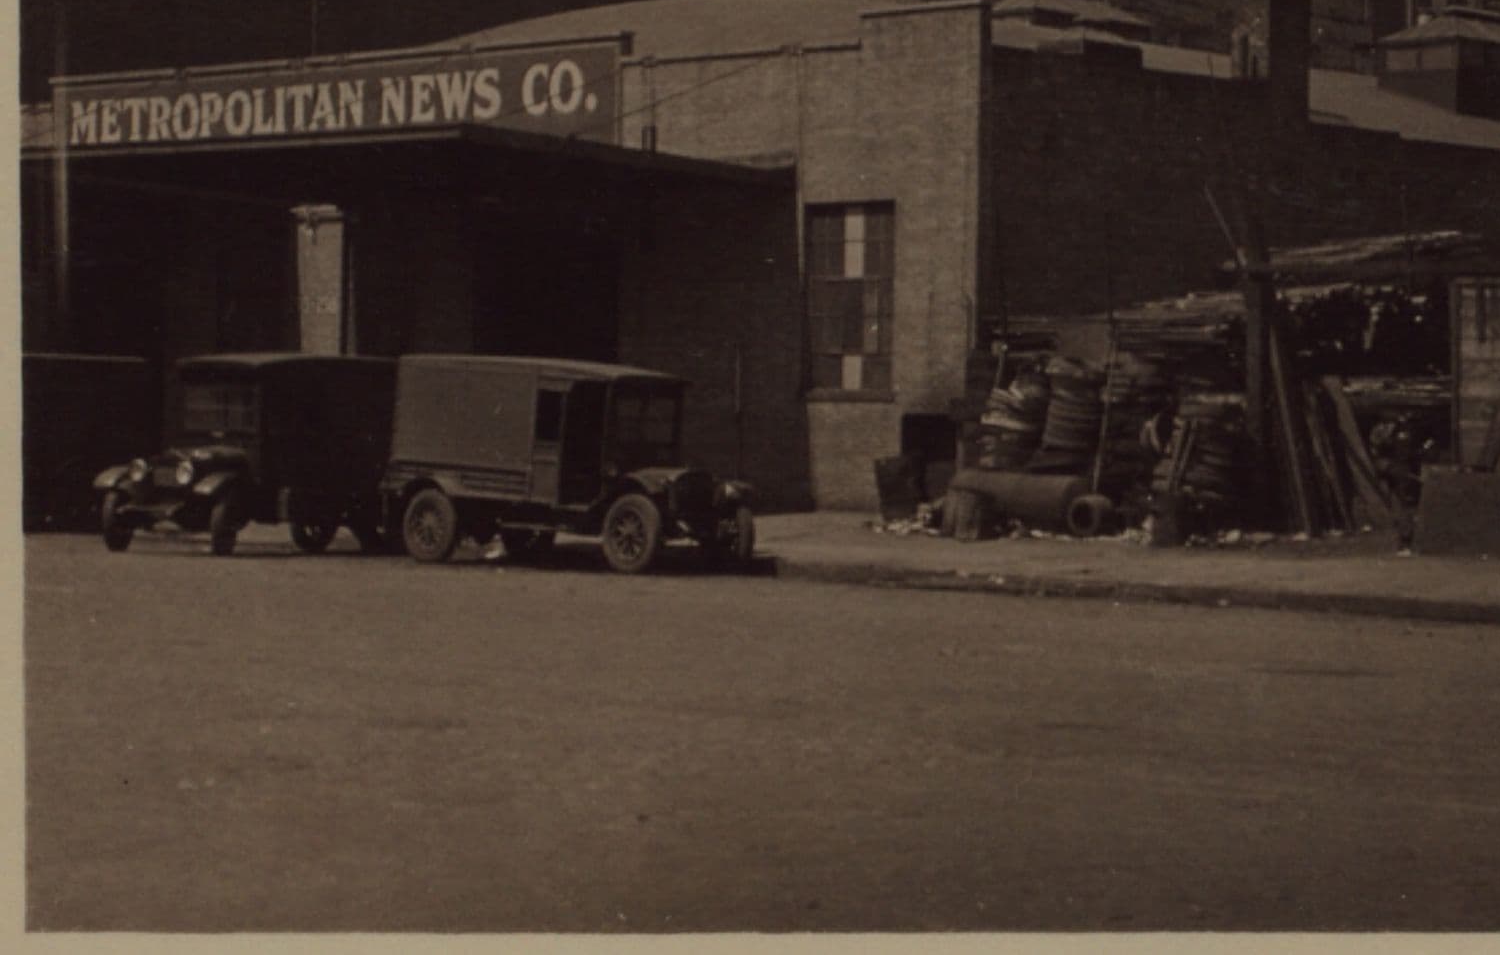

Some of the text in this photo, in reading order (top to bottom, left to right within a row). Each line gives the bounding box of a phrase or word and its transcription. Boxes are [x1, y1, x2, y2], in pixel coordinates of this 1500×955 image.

[69, 60, 598, 146] METROPOLITAN NEWS CO.
